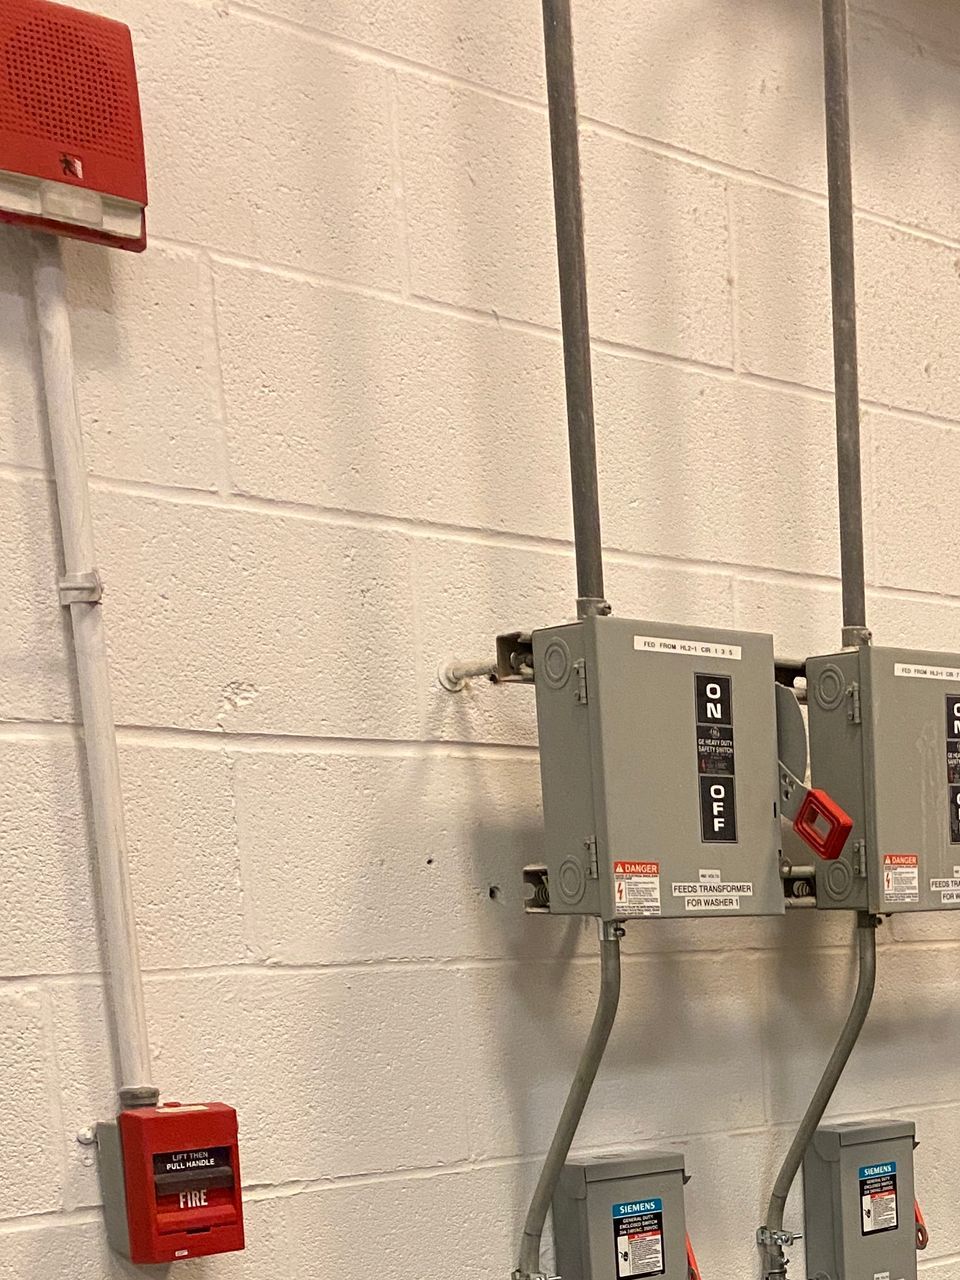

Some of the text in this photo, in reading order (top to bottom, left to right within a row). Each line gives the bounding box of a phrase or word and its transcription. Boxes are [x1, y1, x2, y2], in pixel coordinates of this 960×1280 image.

[659, 642, 677, 650] FROM
[705, 682, 722, 719] ON
[709, 784, 726, 832] OFF
[891, 856, 917, 865] DANGER
[625, 863, 658, 873] DANGER
[673, 884, 752, 893] FEEDS TRANSFORMER
[931, 880, 950, 888] FEEDS
[942, 893, 954, 901] FOR
[686, 898, 702, 907] FOR
[703, 898, 734, 907] WASHER
[172, 1151, 209, 1161] LIFT THEN
[166, 1158, 215, 1170] PULL HANDLE
[864, 1164, 892, 1176] SIEMENS
[179, 1189, 209, 1209] FIRE
[619, 1201, 656, 1214] SIEMENS
